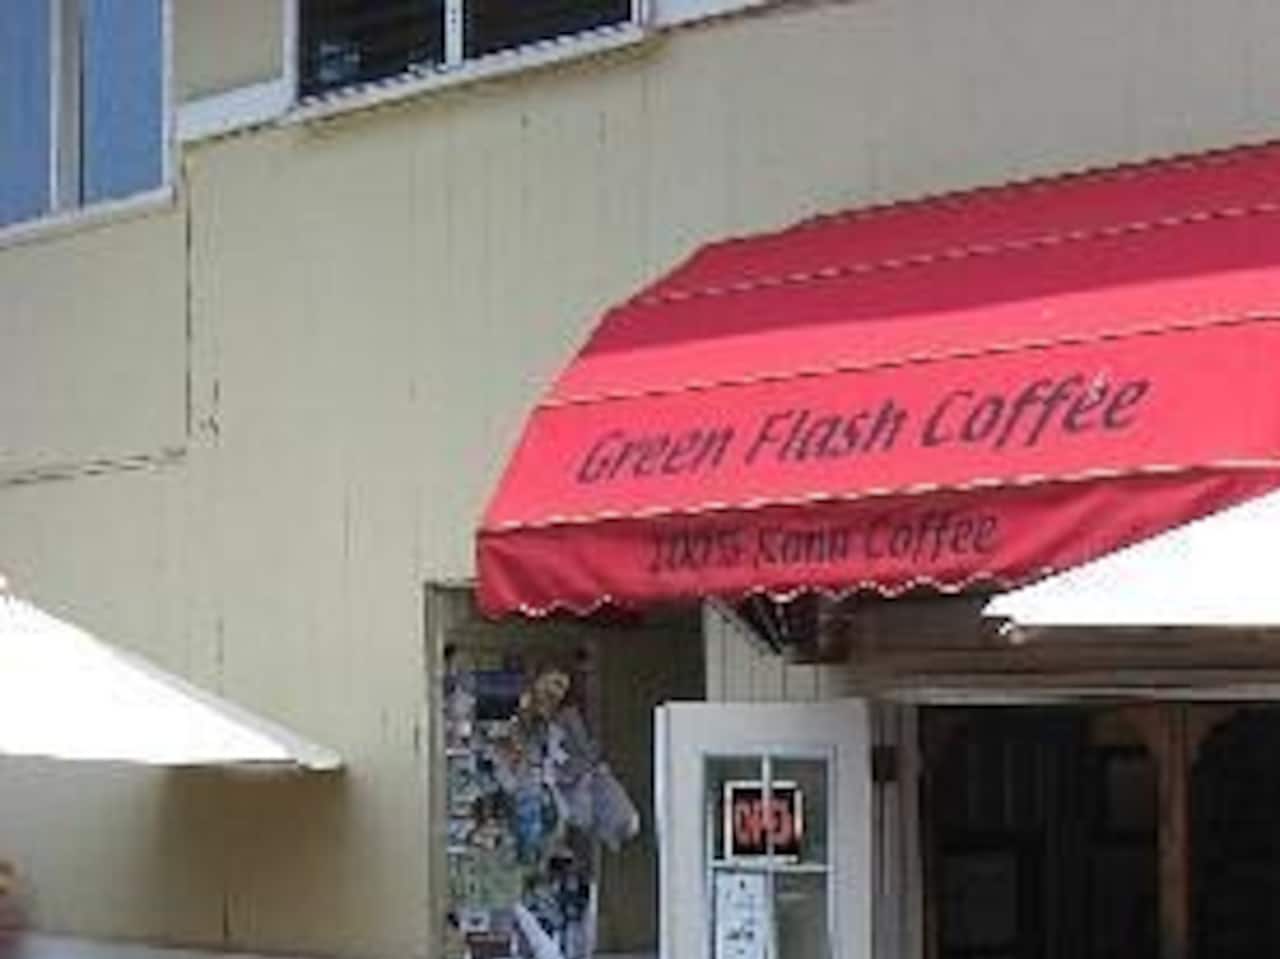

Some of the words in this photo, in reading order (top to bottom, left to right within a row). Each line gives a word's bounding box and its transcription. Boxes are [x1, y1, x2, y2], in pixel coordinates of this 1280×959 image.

[577, 423, 733, 485] Green
[745, 399, 905, 463] Flash
[924, 371, 1151, 451] Coffee
[866, 510, 998, 563] Coffee
